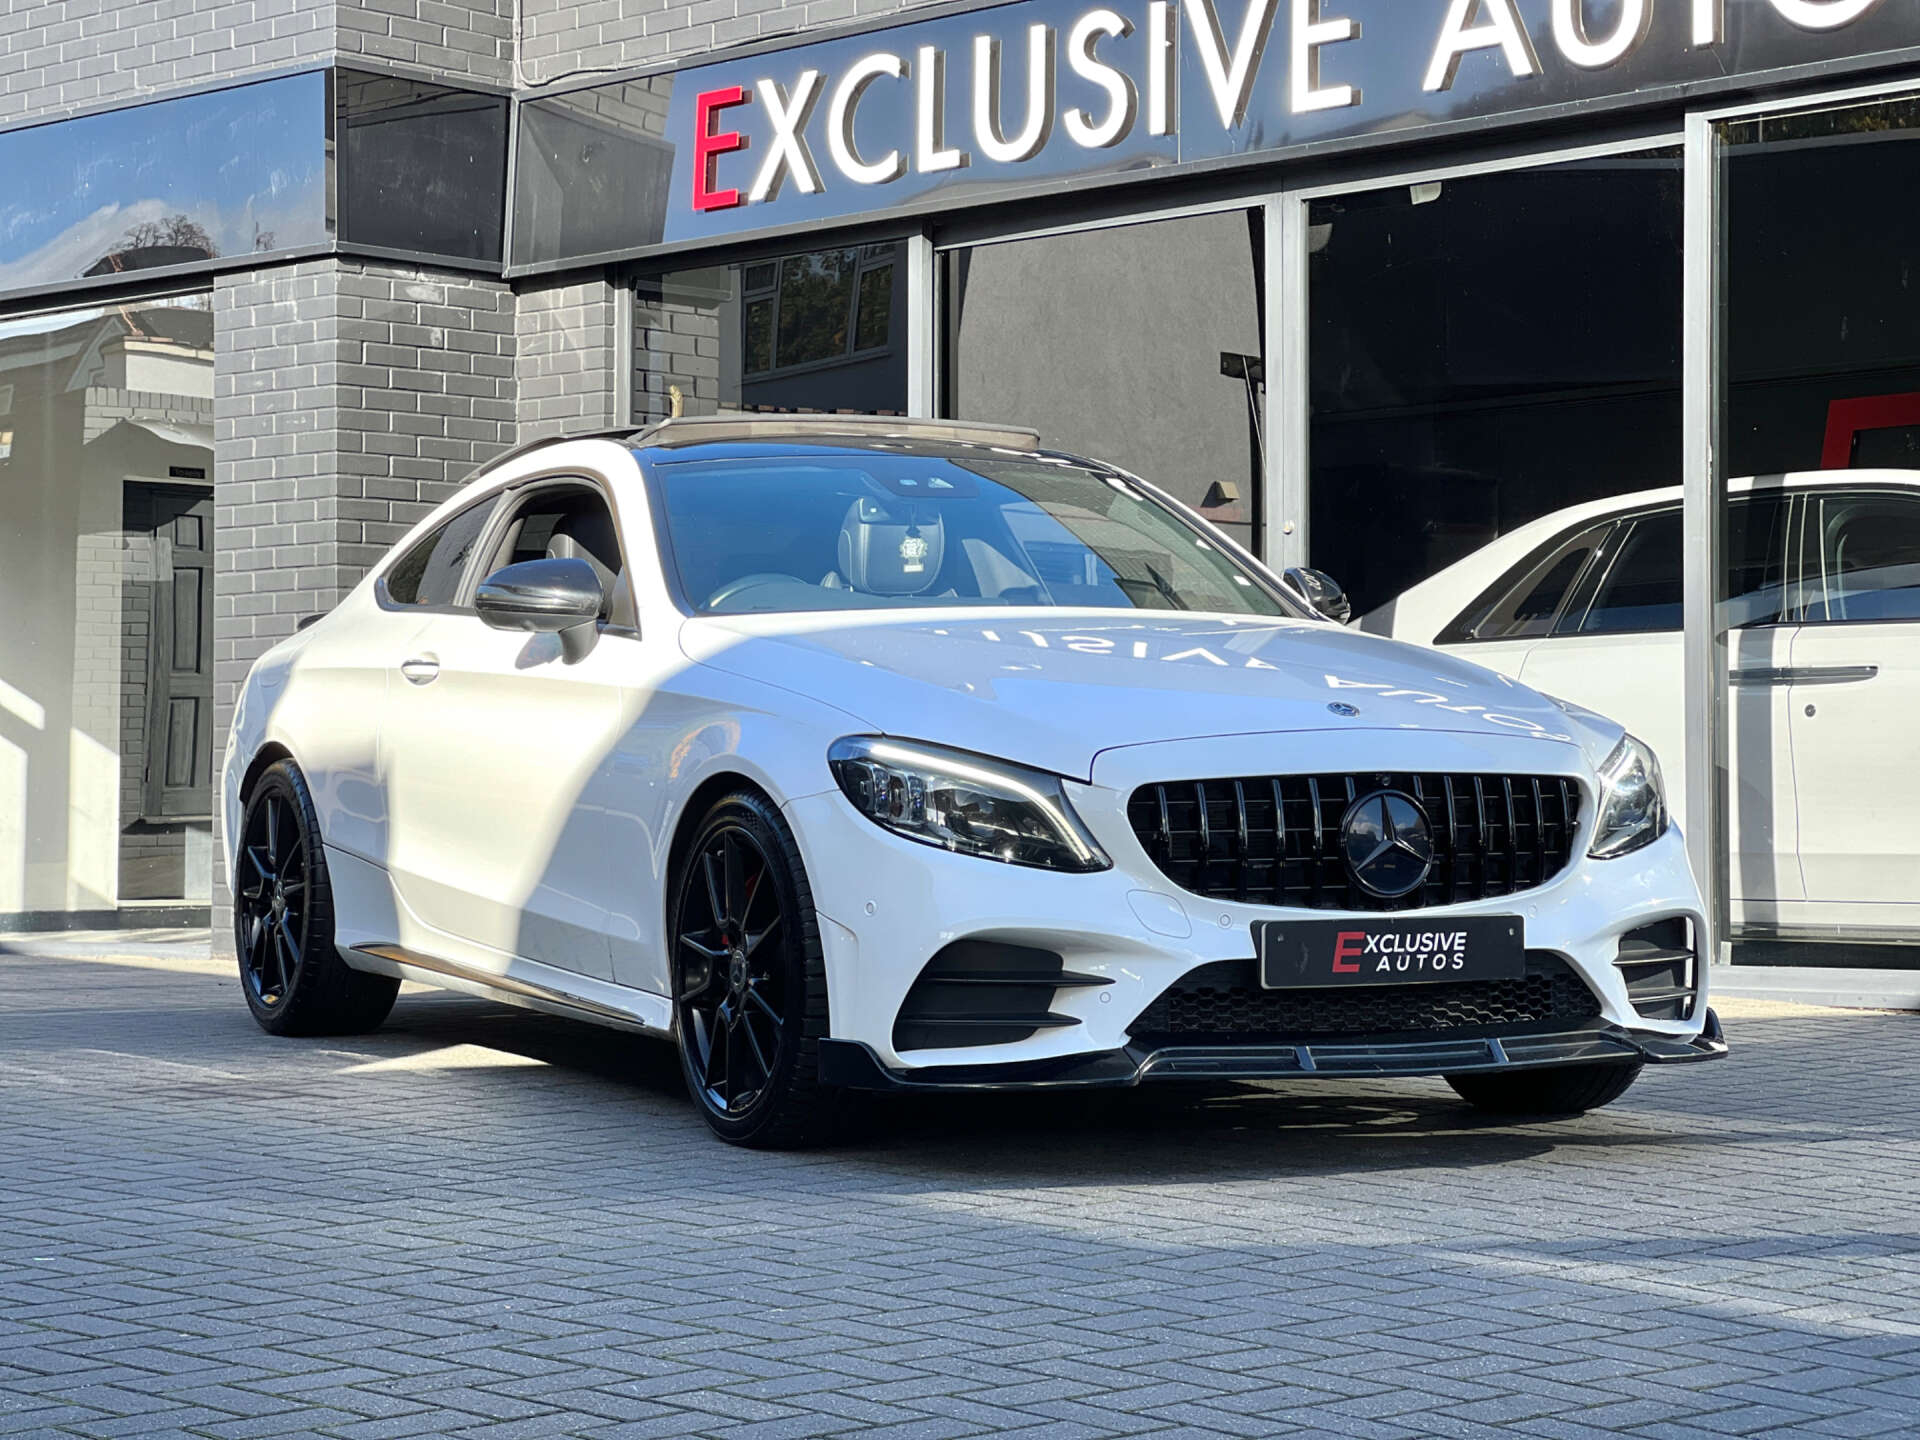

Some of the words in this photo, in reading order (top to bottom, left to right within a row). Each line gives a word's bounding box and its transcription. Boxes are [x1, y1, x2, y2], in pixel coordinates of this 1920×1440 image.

[693, 0, 1360, 211] EXCLUSIVE
[1332, 930, 1467, 973] EXCLUSIVE
[1375, 952, 1465, 972] AUTOS
